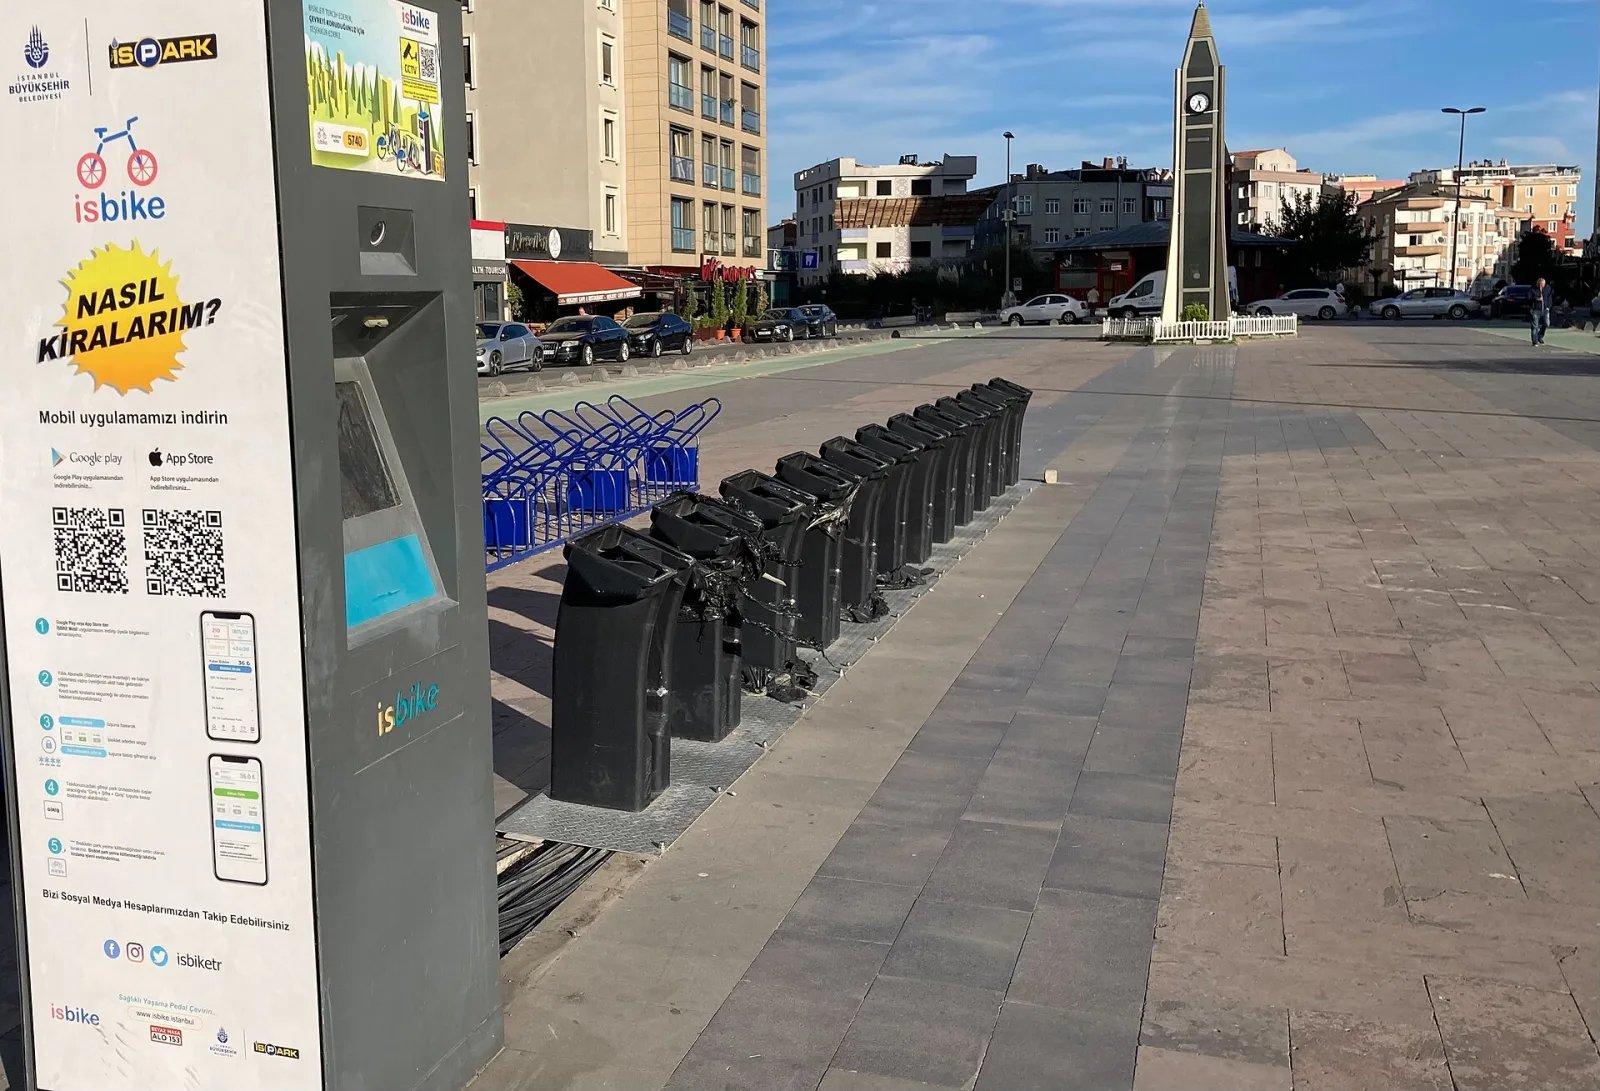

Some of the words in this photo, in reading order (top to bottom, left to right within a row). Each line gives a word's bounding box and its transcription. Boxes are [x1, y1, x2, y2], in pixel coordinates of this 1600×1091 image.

[402, 7, 430, 30] isbike
[17, 72, 60, 82] İSTANBUL
[404, 64, 416, 75] CCTV
[9, 80, 70, 95] BÜYÜKŞEHİR
[19, 92, 62, 103] BELEDİYESİ
[348, 134, 362, 147] 5740
[75, 190, 166, 223] isbike
[485, 266, 506, 276] TOURISM
[77, 277, 165, 319] NASIL
[37, 298, 222, 364] KİRALARIM?
[39, 410, 76, 424] Mobil
[80, 411, 176, 427] uygulamamızı
[181, 411, 228, 425] indirin
[70, 452, 101, 466] Google
[104, 453, 122, 465] play
[166, 453, 186, 466] App
[188, 453, 214, 464] Store
[377, 681, 439, 737] isbike
[42, 889, 58, 900] Bizi
[61, 891, 91, 905] Sosyal
[92, 896, 122, 910] Medya
[124, 900, 200, 920] Hesaplarımızdan
[202, 911, 228, 924] Takip
[230, 914, 290, 932] Edebilirsiniz
[176, 952, 222, 972] isbiketr
[118, 994, 142, 1005] Sağlıklı
[144, 996, 169, 1009] Yaşama
[170, 1002, 188, 1013] Pedal
[51, 1004, 100, 1026] isbike
[136, 1010, 195, 1026] www.isbike.istanbul
[152, 1034, 167, 1042] ALO
[168, 1035, 180, 1044] 153
